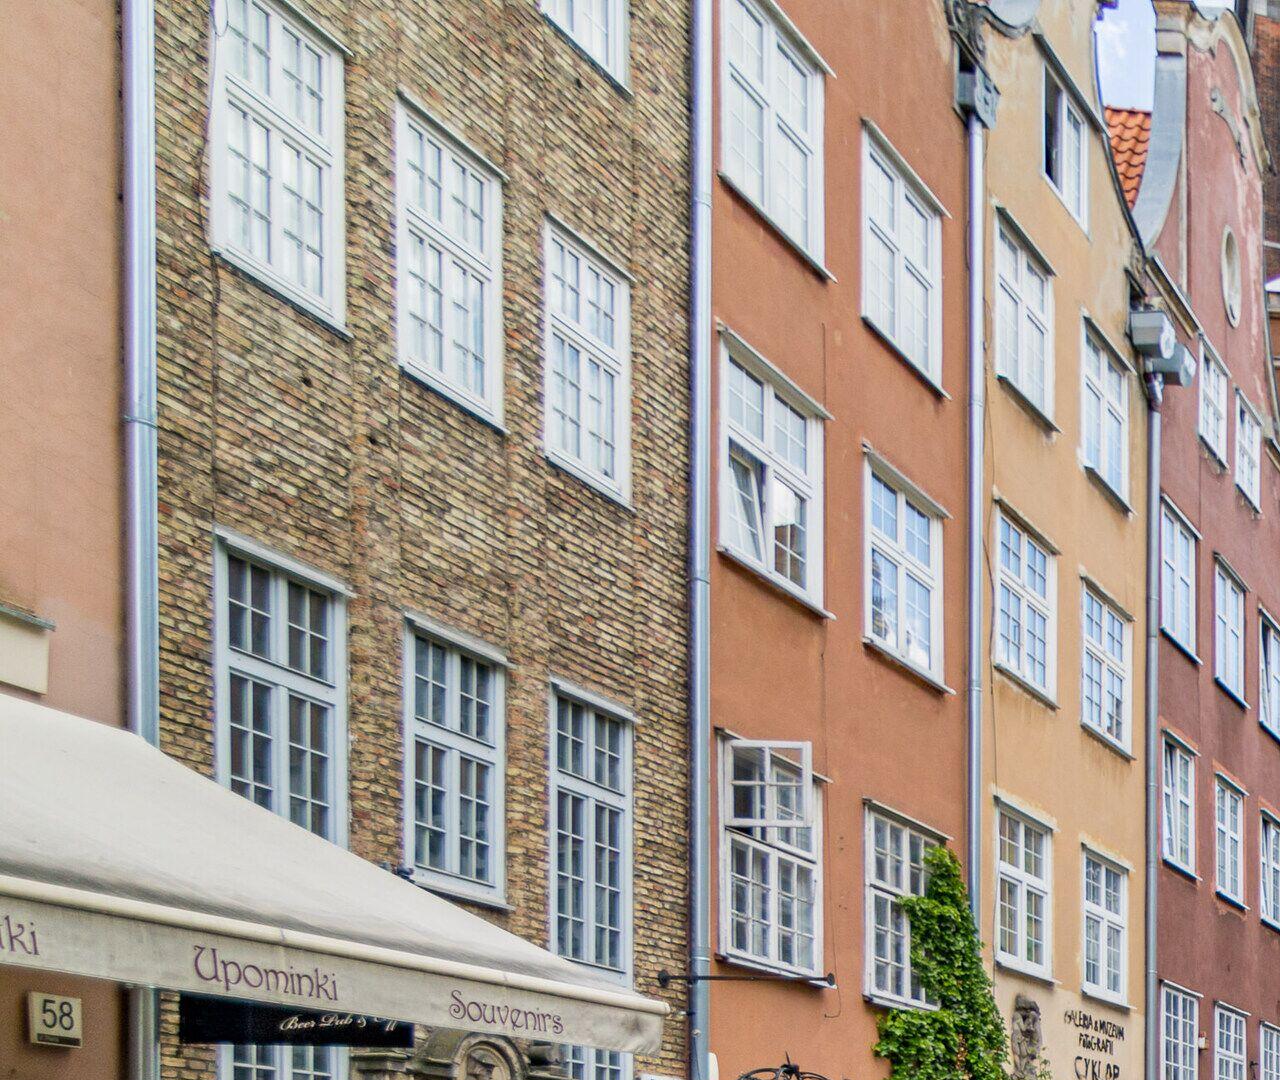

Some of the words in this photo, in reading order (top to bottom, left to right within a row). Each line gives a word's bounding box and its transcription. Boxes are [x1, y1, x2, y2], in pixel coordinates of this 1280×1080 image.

[193, 945, 339, 1001] Upominki
[450, 989, 564, 1035] Souvenirs
[42, 998, 75, 1031] 58
[280, 1015, 316, 1031] Beer
